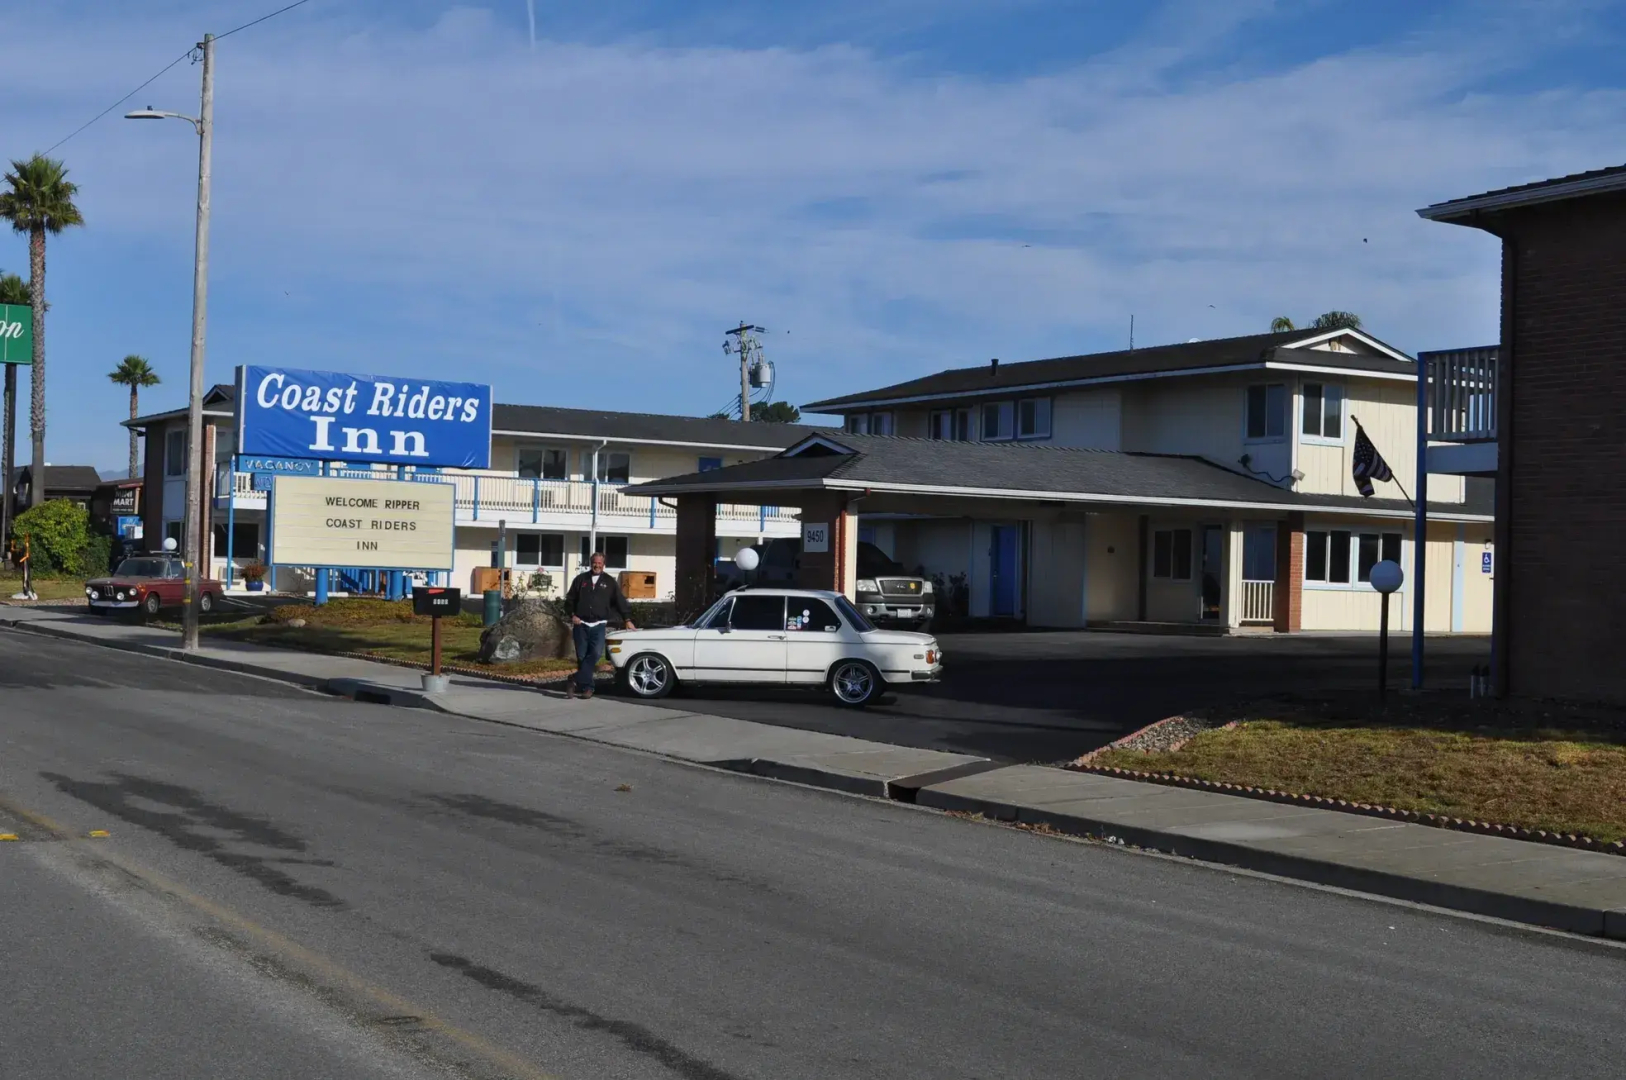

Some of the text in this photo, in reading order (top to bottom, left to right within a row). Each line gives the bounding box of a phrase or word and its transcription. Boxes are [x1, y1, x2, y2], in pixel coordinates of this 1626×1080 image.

[257, 372, 480, 423] Coast Riders
[308, 415, 430, 457] Inn
[245, 459, 314, 472] VACANCY
[113, 498, 134, 506] MART
[325, 496, 420, 510] WELCOME RIPPER
[326, 518, 417, 531] COAST RIDERS
[807, 530, 824, 543] 9450
[356, 541, 378, 551] INN
